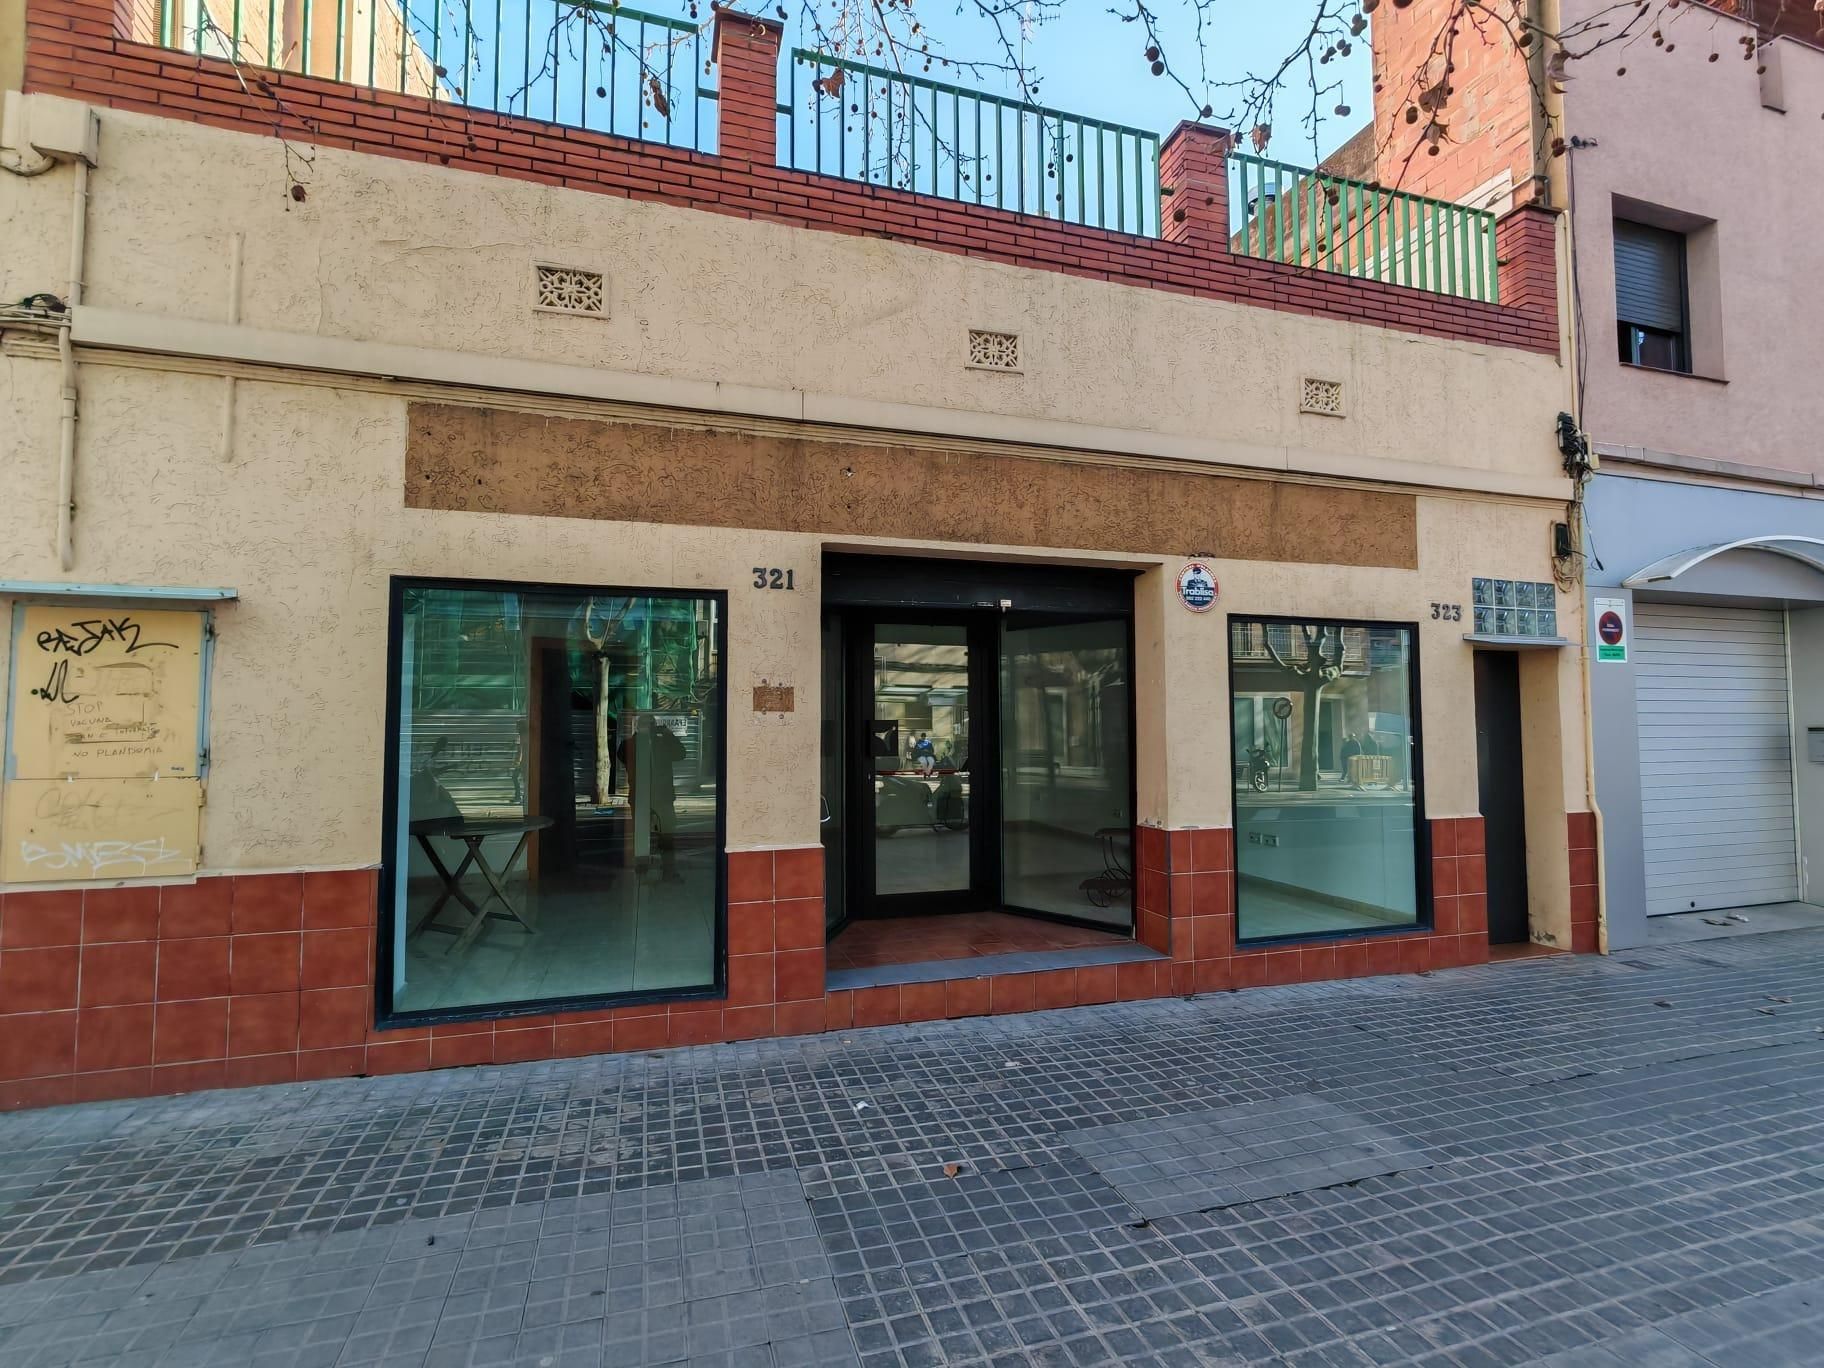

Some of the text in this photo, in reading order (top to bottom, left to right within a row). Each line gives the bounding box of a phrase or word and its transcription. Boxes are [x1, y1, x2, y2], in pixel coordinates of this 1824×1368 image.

[752, 567, 794, 590] 321
[1182, 586, 1214, 596] Trablisa
[1431, 602, 1461, 621] 323
[72, 750, 89, 758] NO
